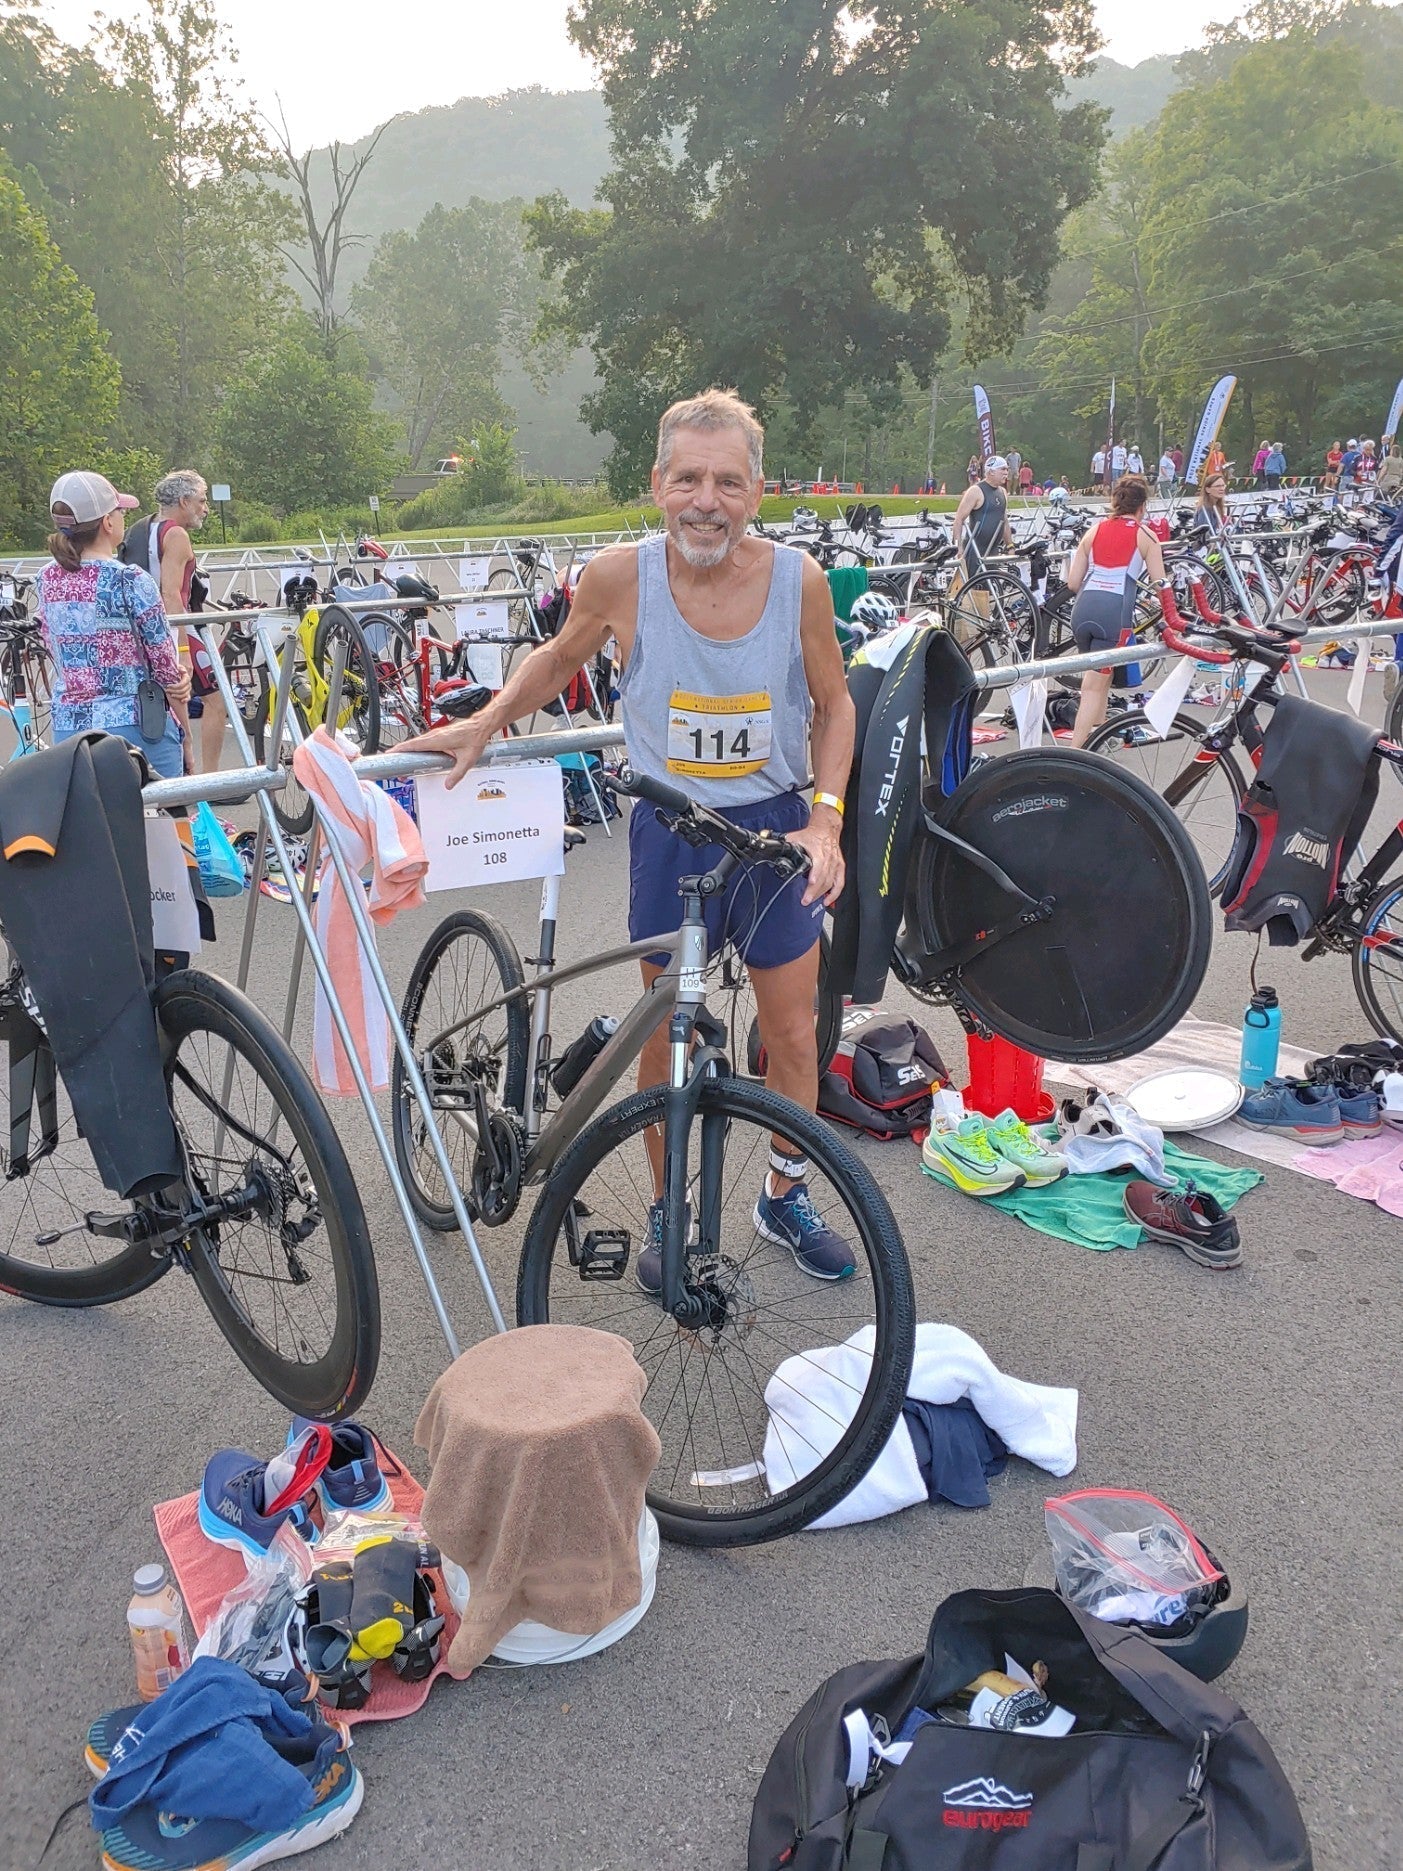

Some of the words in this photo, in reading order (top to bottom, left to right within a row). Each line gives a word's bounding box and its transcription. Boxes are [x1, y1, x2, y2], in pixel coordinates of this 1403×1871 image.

[980, 418, 992, 457] BIKE
[689, 728, 751, 760] 114
[992, 795, 1067, 823] aerojacket
[446, 834, 469, 847] Joe
[472, 826, 540, 844] Simonetta
[483, 852, 508, 866] 108
[150, 888, 176, 902] ocker
[682, 979, 700, 989] 109
[405, 987, 421, 1037] CONNEC
[620, 1099, 657, 1121] EXPERT
[631, 1113, 665, 1132] TRAGER
[216, 1496, 242, 1527] HOKA
[714, 1496, 775, 1514] BONTRAGER
[943, 1808, 1033, 1832] eurogear
